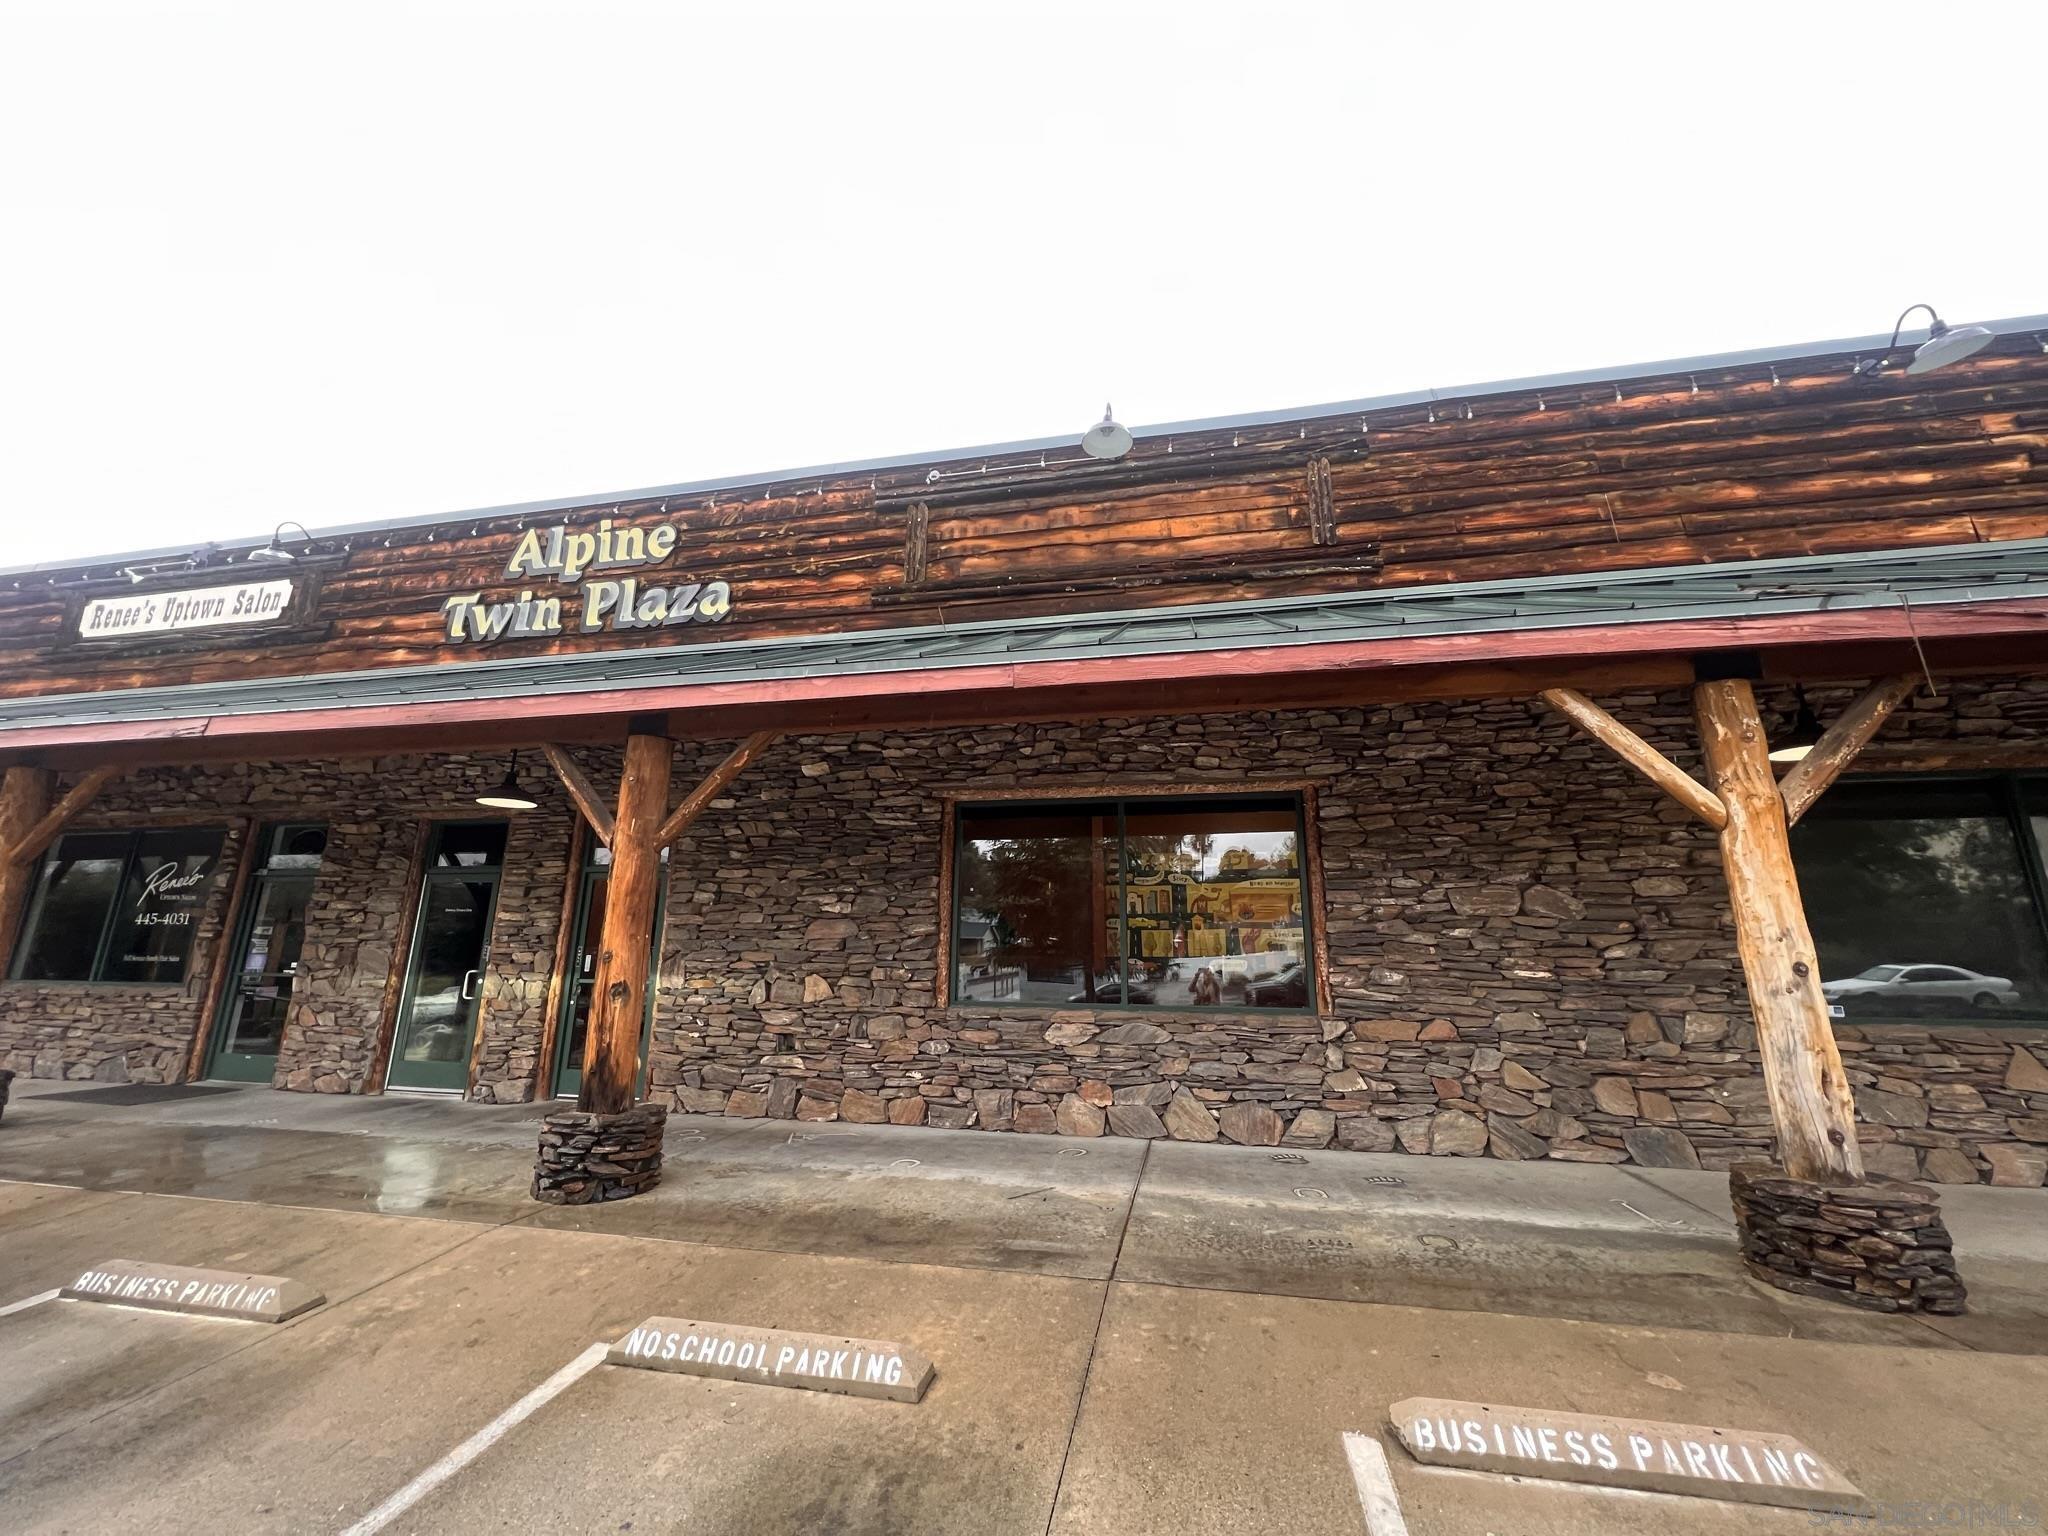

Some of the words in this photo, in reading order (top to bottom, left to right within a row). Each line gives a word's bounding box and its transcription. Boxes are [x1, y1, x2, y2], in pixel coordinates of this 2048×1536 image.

[504, 519, 678, 582] Alpine
[89, 600, 156, 630] Renee's
[162, 597, 226, 627] Uptown
[232, 587, 282, 615] Salon
[445, 590, 562, 643] Twin
[580, 578, 731, 633] Plaza
[134, 912, 190, 925] 445-4031
[73, 1271, 179, 1299] BUSINESS
[177, 1280, 276, 1312] PARKING
[775, 1346, 904, 1386] PARKING
[1413, 1418, 1619, 1470] BUSINESS
[1629, 1434, 1822, 1489] PARKING
